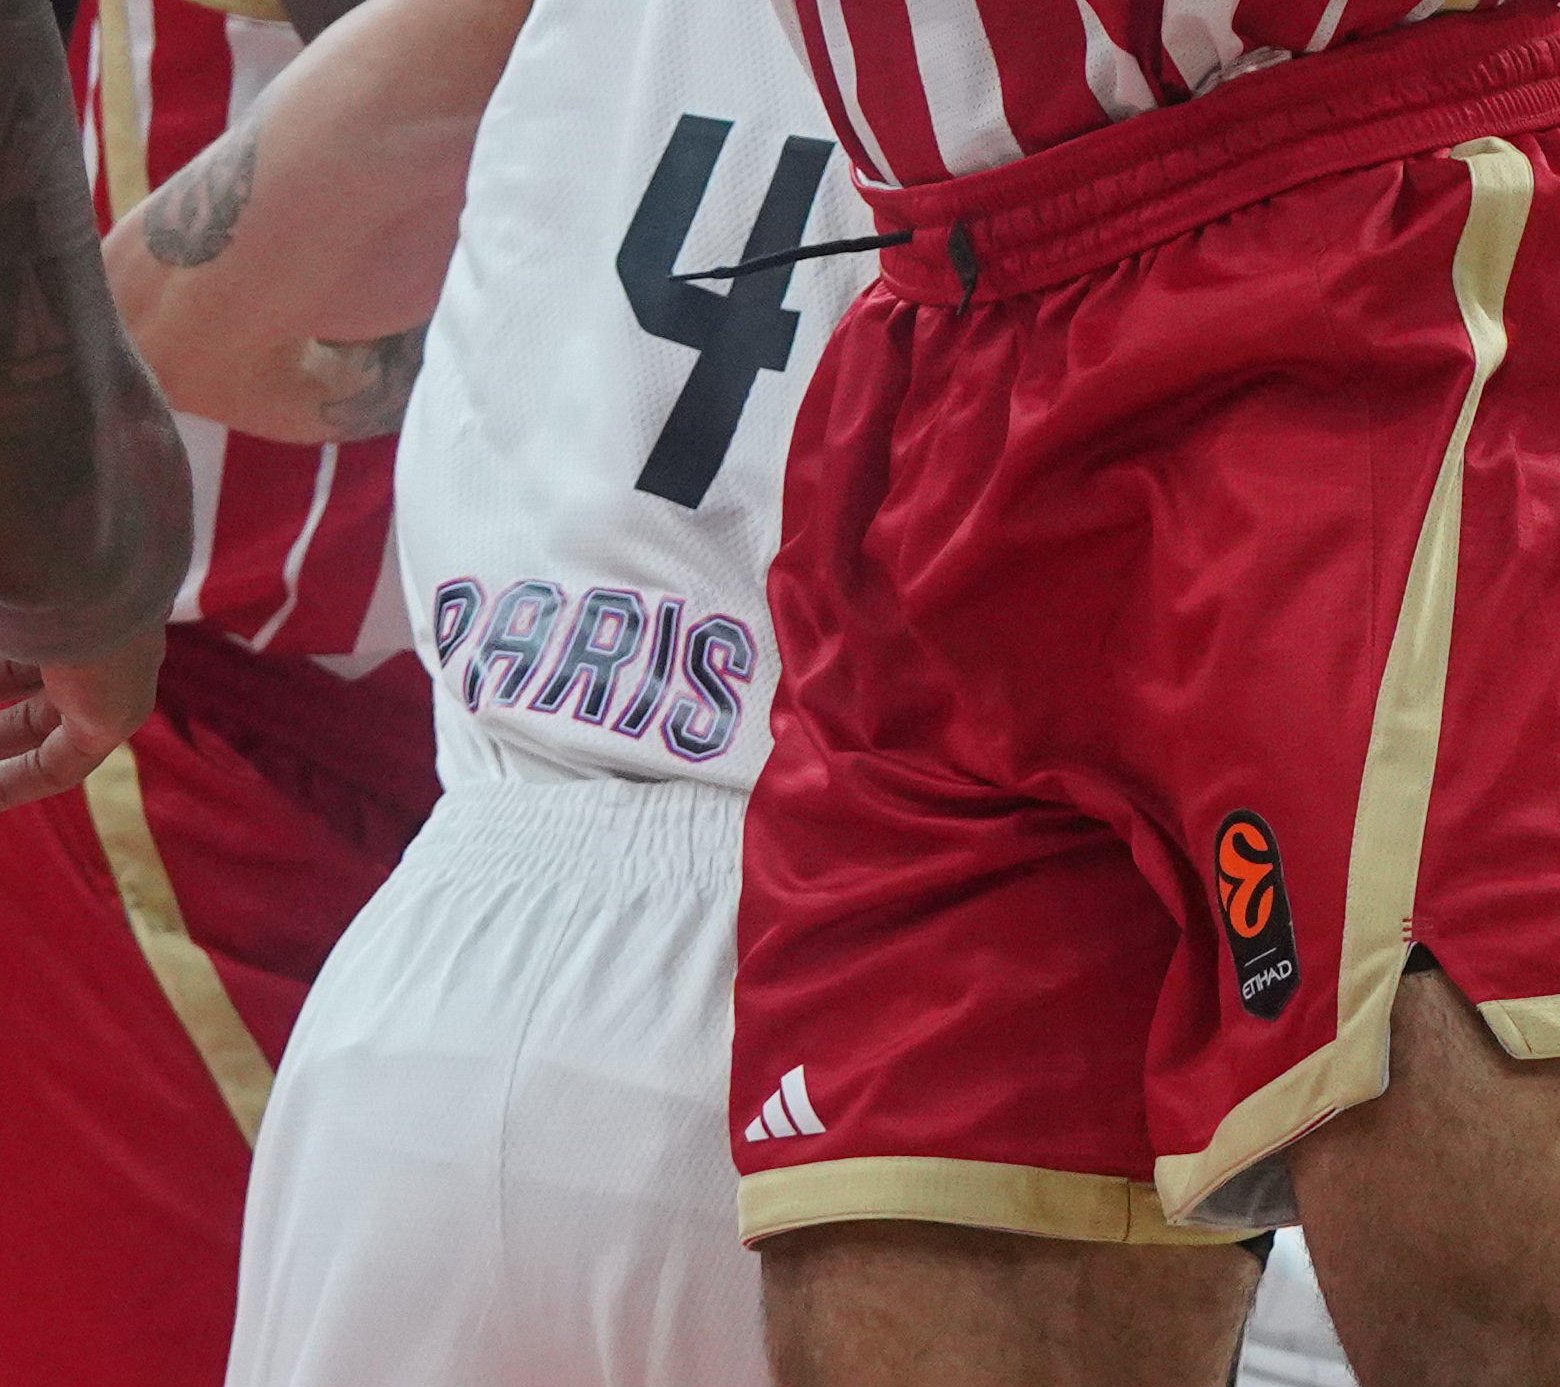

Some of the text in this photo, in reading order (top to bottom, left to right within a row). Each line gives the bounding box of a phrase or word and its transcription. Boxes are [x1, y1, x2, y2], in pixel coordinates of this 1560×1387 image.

[616, 113, 837, 510] 4
[436, 575, 759, 763] PARIS
[1242, 959, 1293, 1000] ETIHAD
